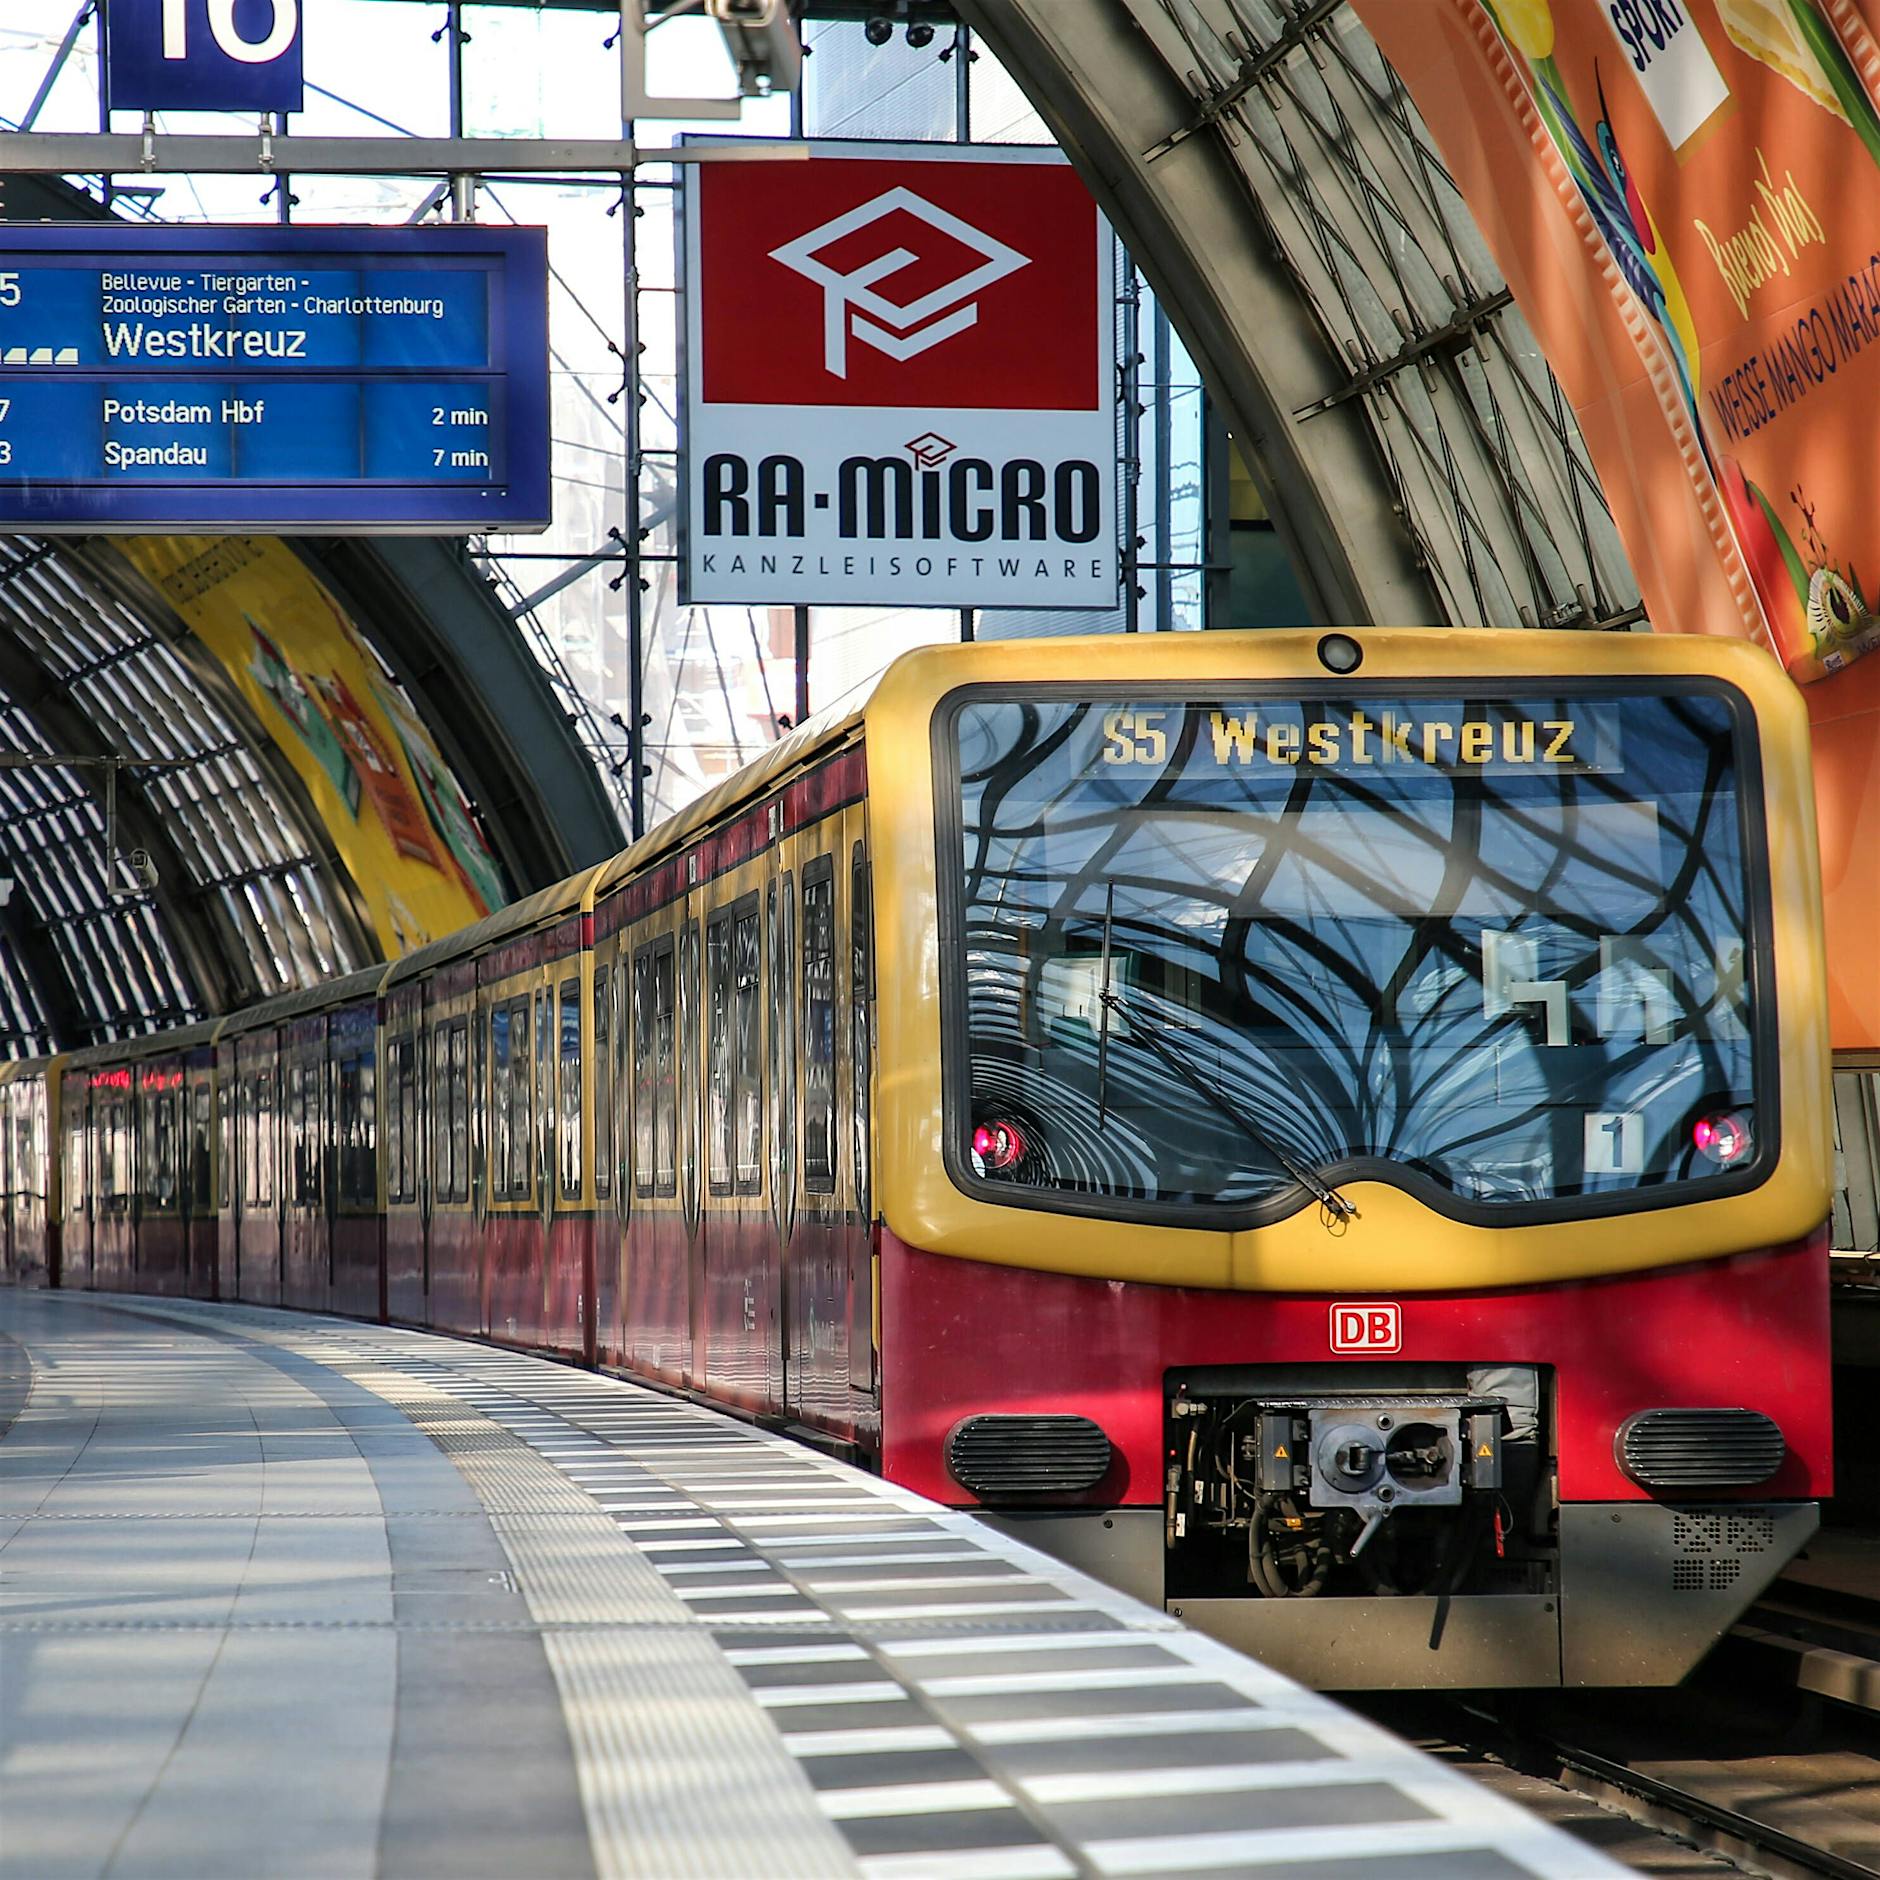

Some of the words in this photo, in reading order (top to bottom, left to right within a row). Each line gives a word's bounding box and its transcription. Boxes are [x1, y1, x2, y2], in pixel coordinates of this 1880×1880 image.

[0, 272, 21, 307] 5
[102, 274, 181, 291] Bellevue
[200, 274, 296, 296] Tiergarten
[102, 296, 217, 318] Zoologischer
[223, 297, 286, 314] Garten
[304, 296, 444, 319] Charlottenburg
[103, 322, 306, 358] Westkreuz
[1708, 355, 1776, 445] WEISSE
[1762, 307, 1836, 412] MANGO
[103, 400, 211, 424] Potsdam
[221, 400, 264, 424] Hbf
[432, 407, 445, 425] 2
[450, 407, 488, 425] min
[104, 441, 207, 470] Spandau
[432, 448, 445, 467] 7
[451, 448, 489, 467] min
[702, 554, 1102, 579] KANZLEISOFTWARE
[1103, 711, 1166, 765] S5
[1209, 710, 1576, 765] Westkreuz
[1601, 1115, 1623, 1168] 1
[1340, 1312, 1392, 1345] DB
